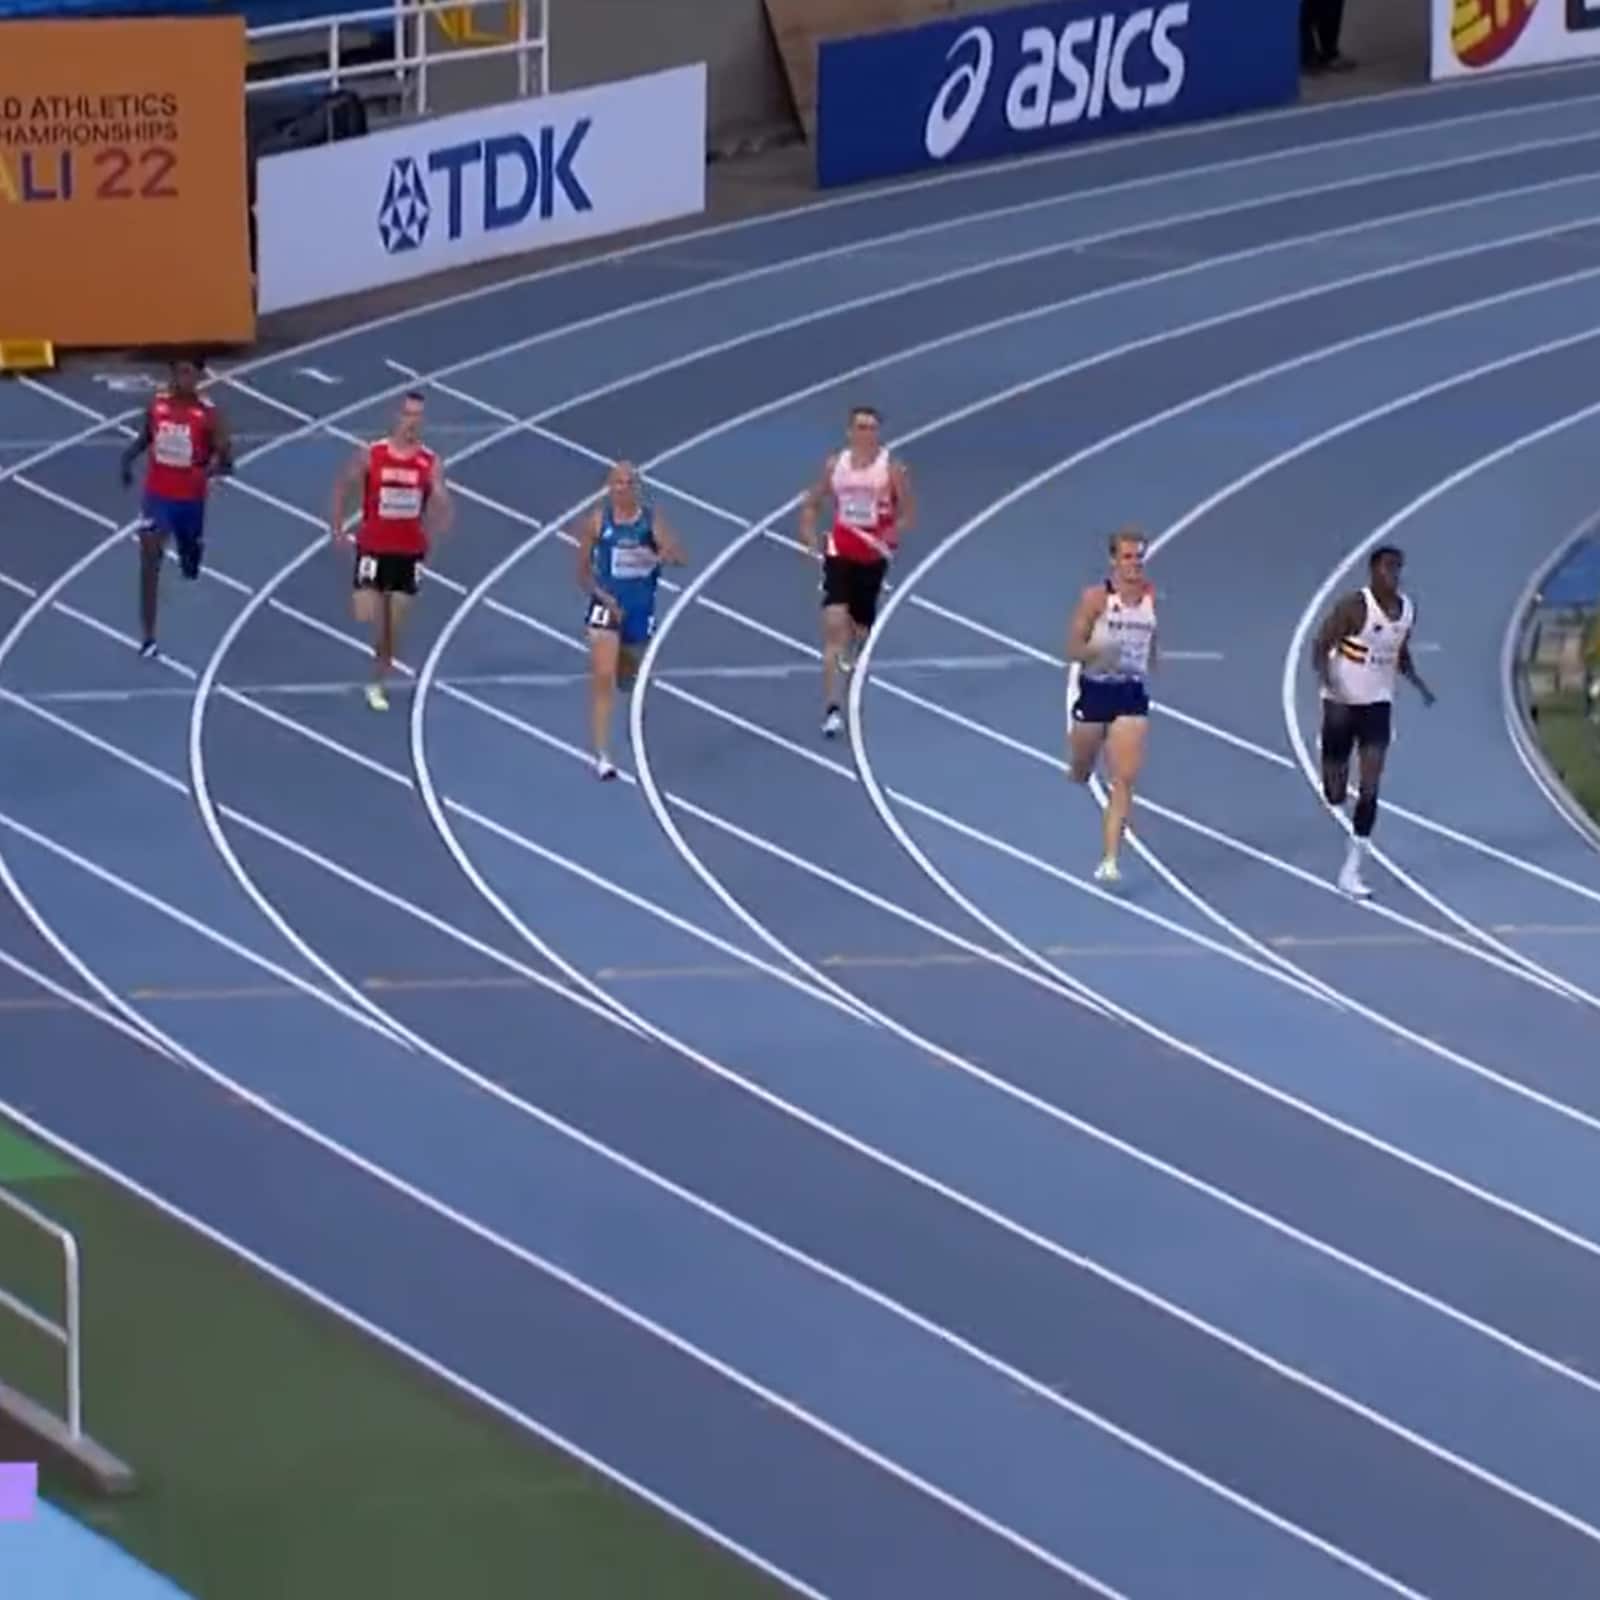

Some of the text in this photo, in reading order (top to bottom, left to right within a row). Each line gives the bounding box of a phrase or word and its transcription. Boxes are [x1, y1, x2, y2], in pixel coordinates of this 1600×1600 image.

[30, 92, 178, 119] ATHLETICS
[1006, 1, 1190, 131] asics
[94, 146, 179, 199] 22
[427, 117, 593, 241] TDK
